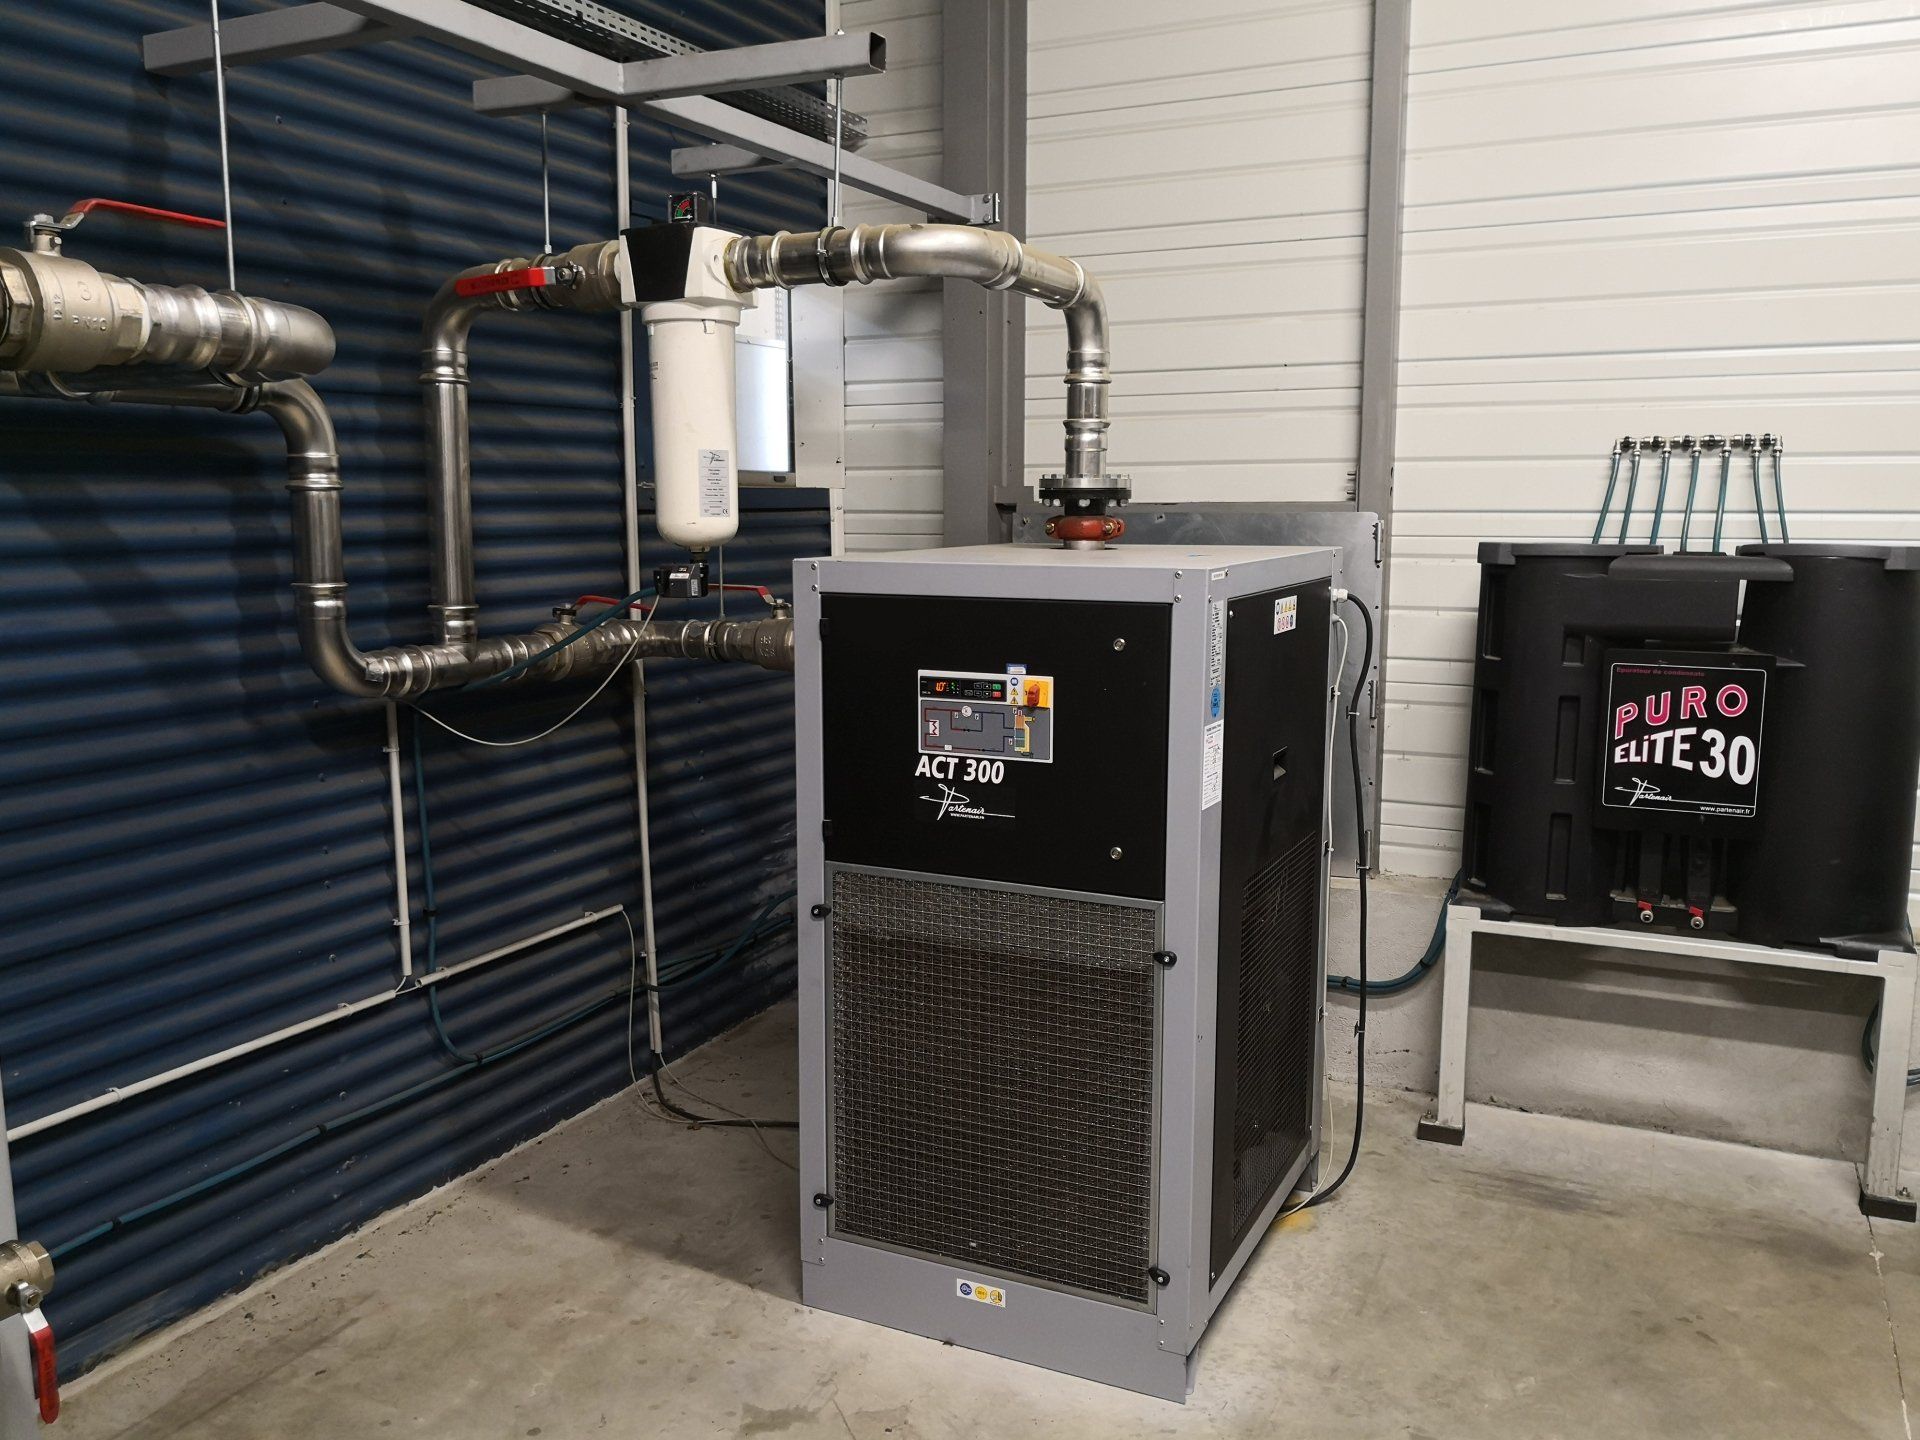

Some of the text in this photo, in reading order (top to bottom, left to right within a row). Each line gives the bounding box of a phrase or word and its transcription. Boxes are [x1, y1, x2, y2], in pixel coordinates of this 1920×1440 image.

[1614, 684, 1748, 740] PURO
[914, 755, 1005, 785] ACT 300
[1699, 728, 1756, 786] 30
[1699, 805, 1751, 815] www.partenair.fr
